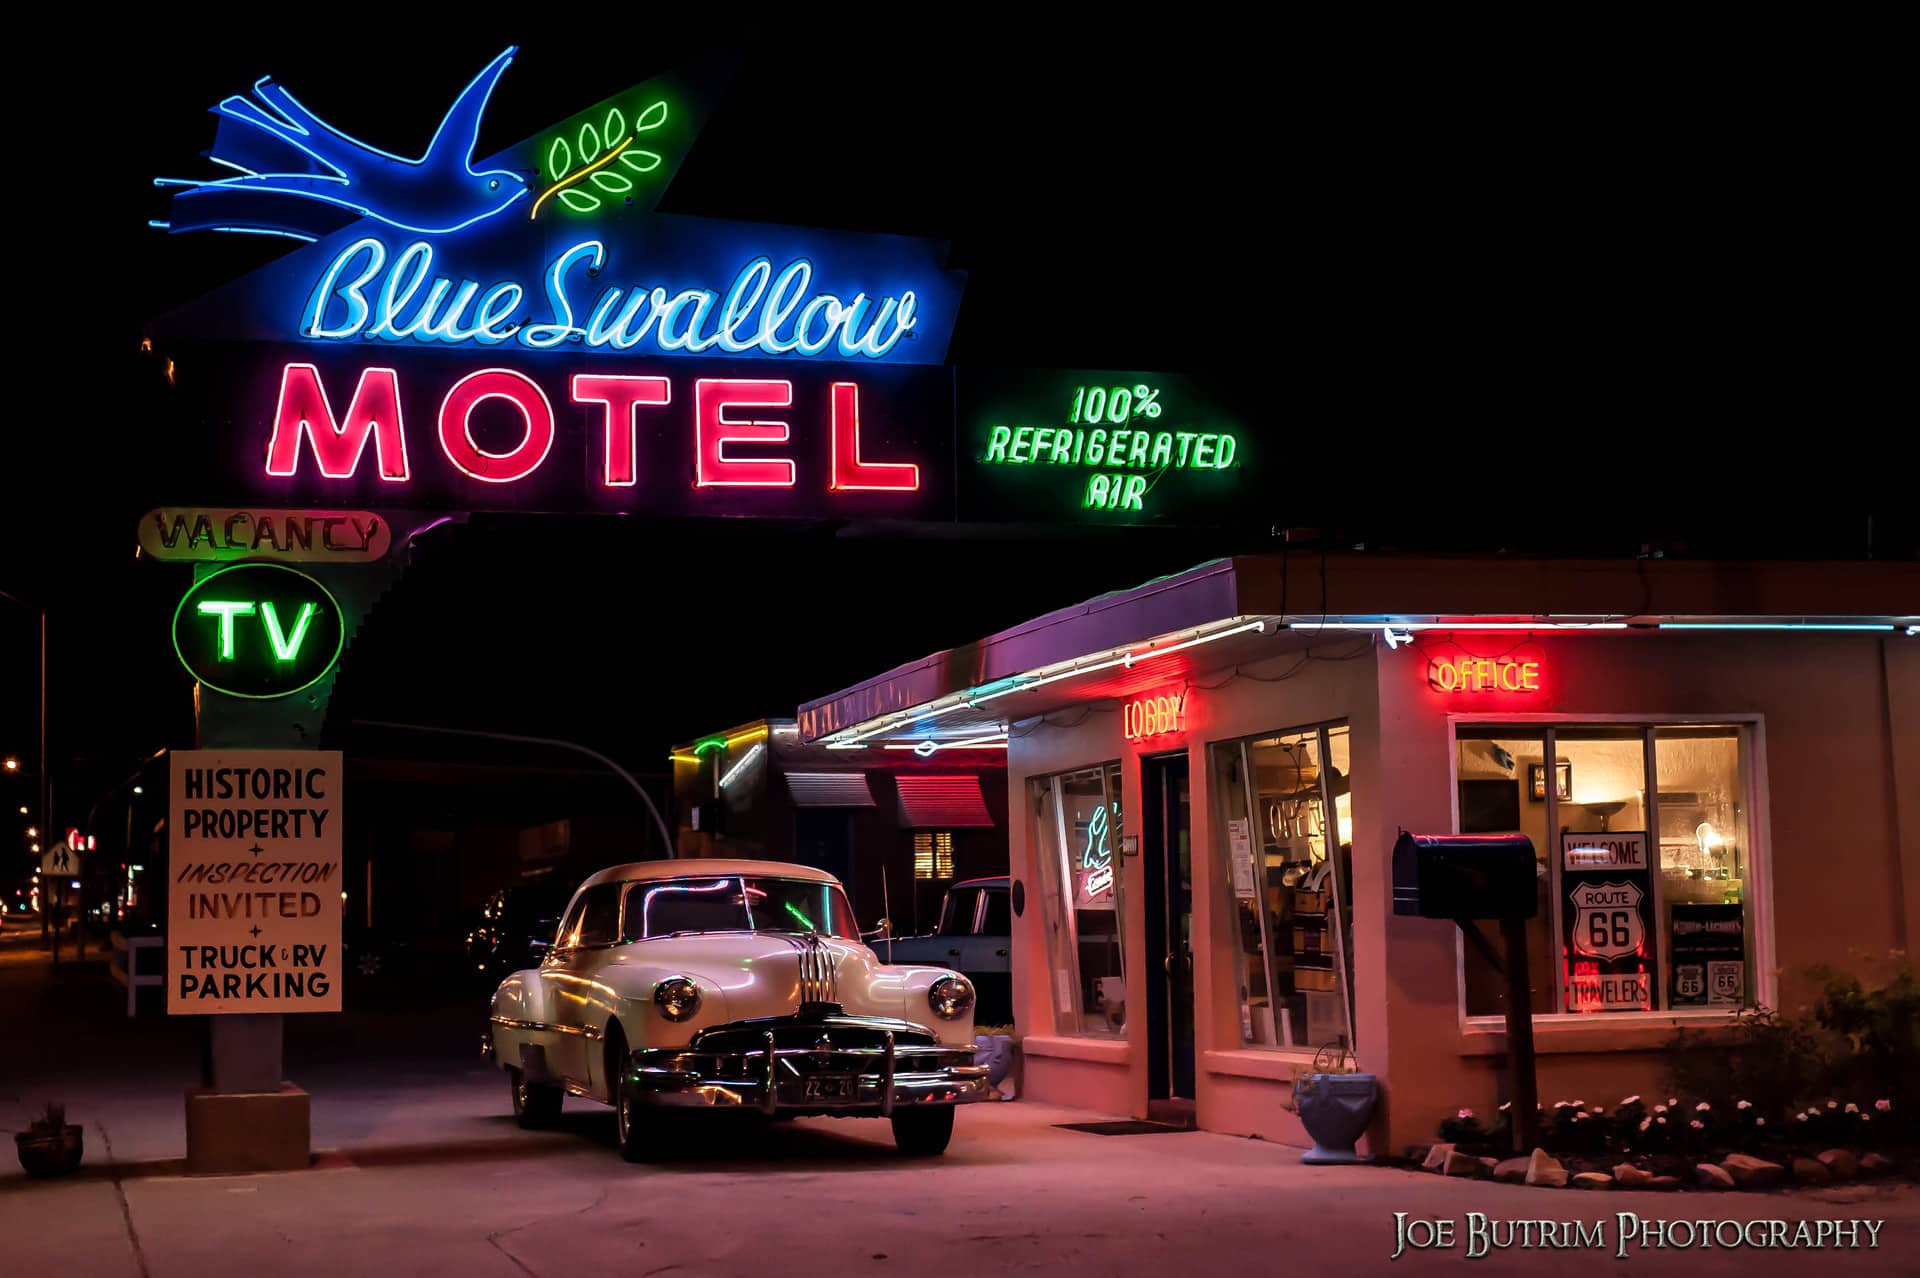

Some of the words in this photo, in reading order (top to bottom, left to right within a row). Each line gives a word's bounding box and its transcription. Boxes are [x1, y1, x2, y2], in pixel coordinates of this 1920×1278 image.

[301, 239, 522, 343] Blue
[520, 239, 919, 359] Swallow
[1070, 384, 1162, 424] 100%
[265, 362, 920, 491] MOTEL
[985, 426, 1236, 469] REFRIGERATED
[1083, 473, 1146, 510] AIR
[197, 600, 317, 663] TV
[1428, 657, 1539, 692] OFFICE
[1124, 694, 1182, 739] LOBBY
[185, 768, 326, 800] HISTORIC
[183, 808, 330, 839] PROPERTY
[1567, 840, 1641, 865] WELCOME
[177, 862, 338, 884] INSPECTION
[189, 892, 321, 919] INVITED
[1585, 891, 1629, 905] ROUTE
[1588, 911, 1630, 948] 66
[180, 944, 276, 970] TRUCK
[292, 944, 328, 967] RV
[179, 972, 331, 1000] PARKING
[1571, 979, 1650, 1003] TRAVELERS
[1682, 981, 1699, 993] 66
[1718, 975, 1735, 988] 66
